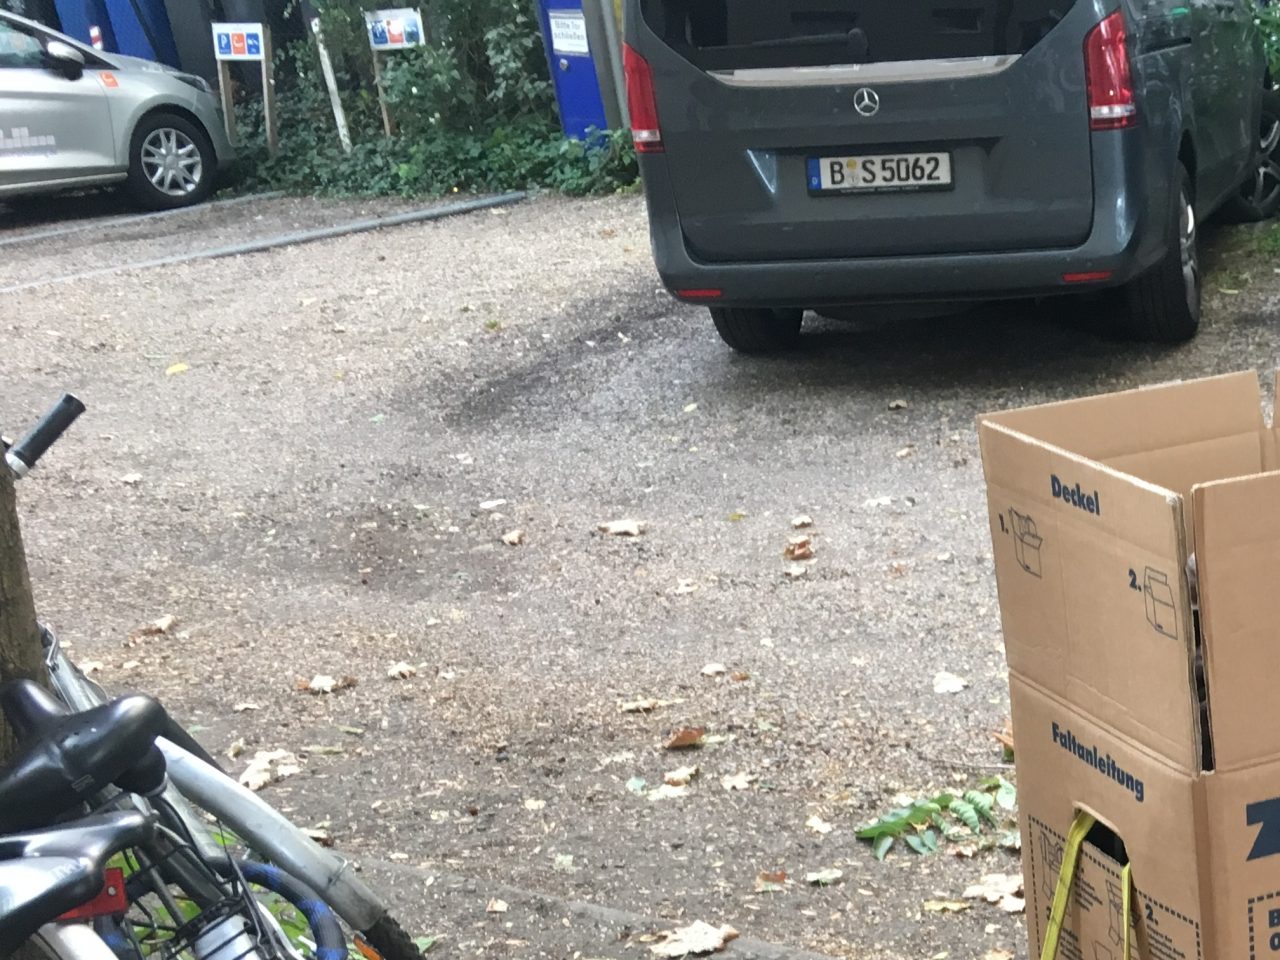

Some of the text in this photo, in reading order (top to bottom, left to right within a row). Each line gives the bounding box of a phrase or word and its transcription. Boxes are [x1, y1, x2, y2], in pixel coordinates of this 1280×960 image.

[829, 160, 845, 186] B
[880, 155, 941, 183] 5062
[1050, 473, 1100, 517] Deckel
[1127, 568, 1142, 592] 2.
[1051, 722, 1145, 800] Faltanleitung
